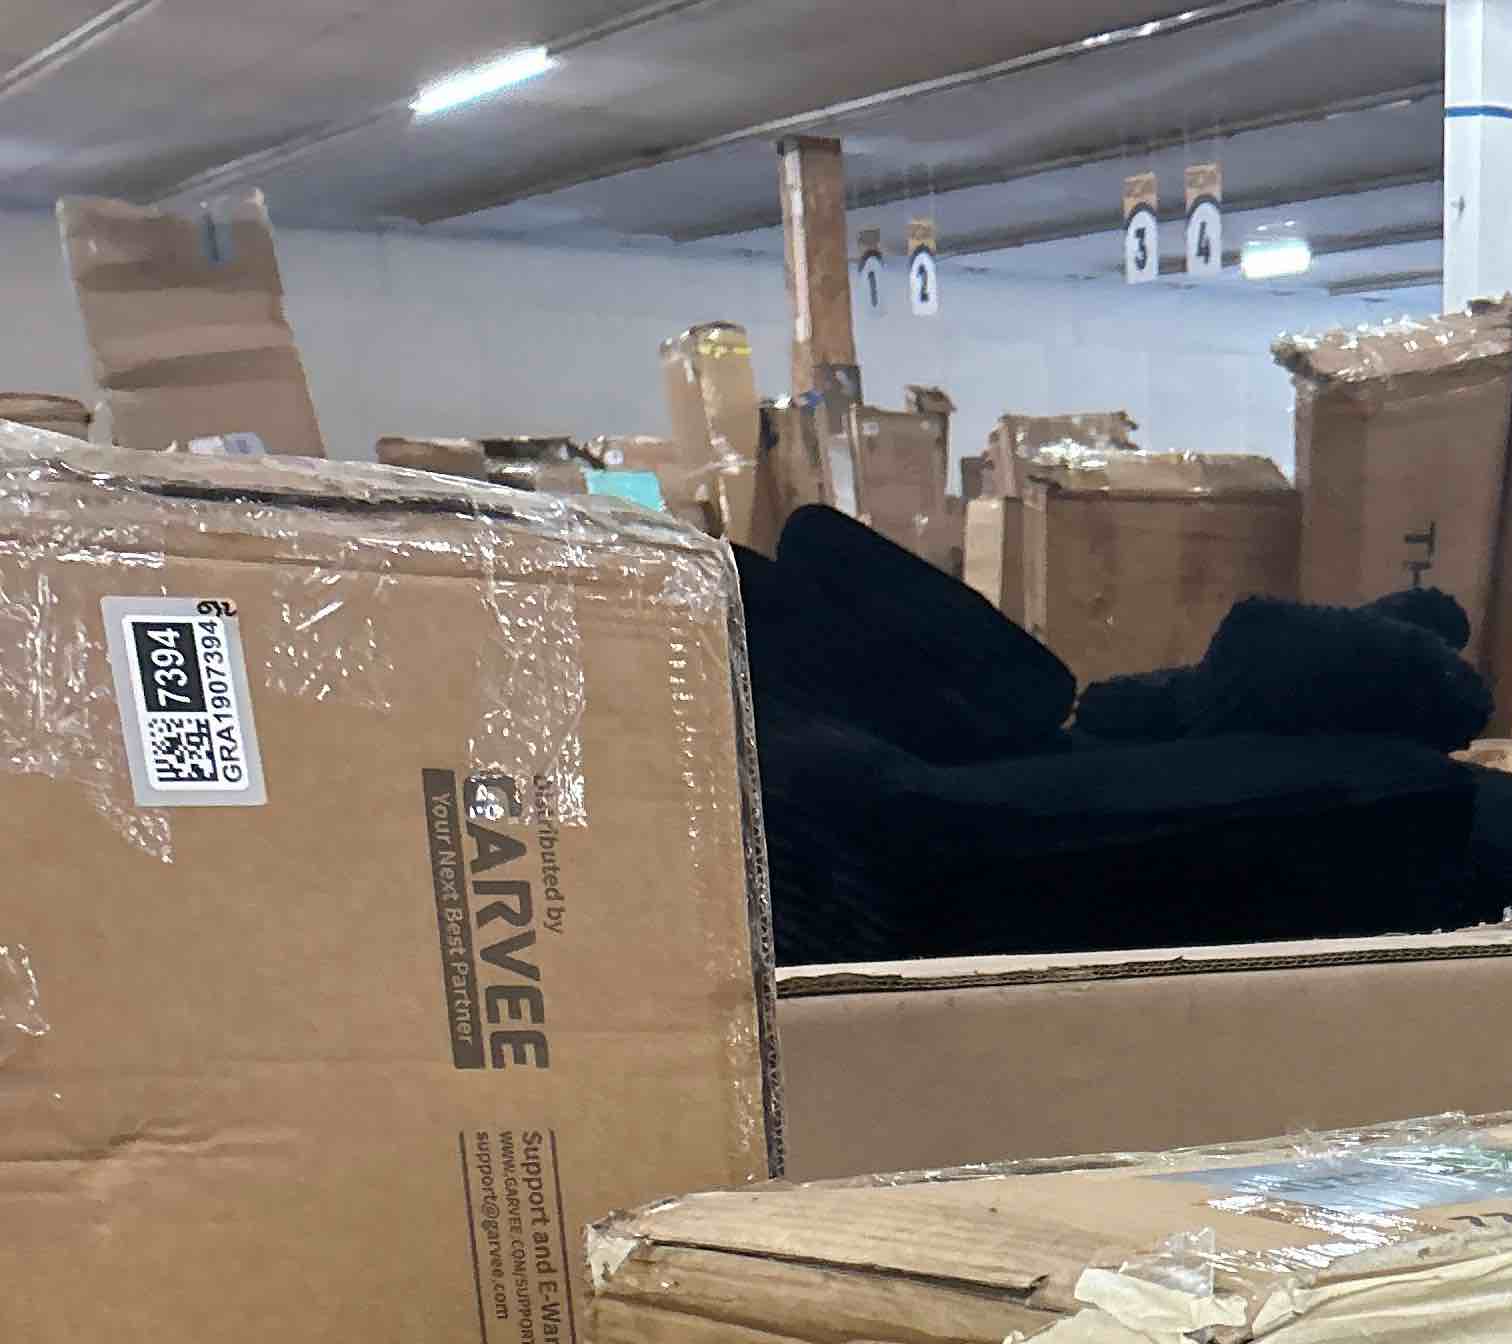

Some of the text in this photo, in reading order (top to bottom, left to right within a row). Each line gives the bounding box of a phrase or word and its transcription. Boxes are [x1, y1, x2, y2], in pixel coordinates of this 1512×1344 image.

[1134, 226, 1148, 272] 3
[1195, 221, 1211, 264] 4
[868, 270, 878, 307] 1
[916, 263, 929, 303] 2
[146, 627, 192, 707] 7394
[197, 620, 243, 784] GRA1907394
[431, 792, 473, 1045] Your Next Best Partner
[544, 907, 567, 937] by
[522, 1130, 551, 1227] Support
[476, 1130, 510, 1320] support@garvee.com
[533, 1231, 554, 1275] and
